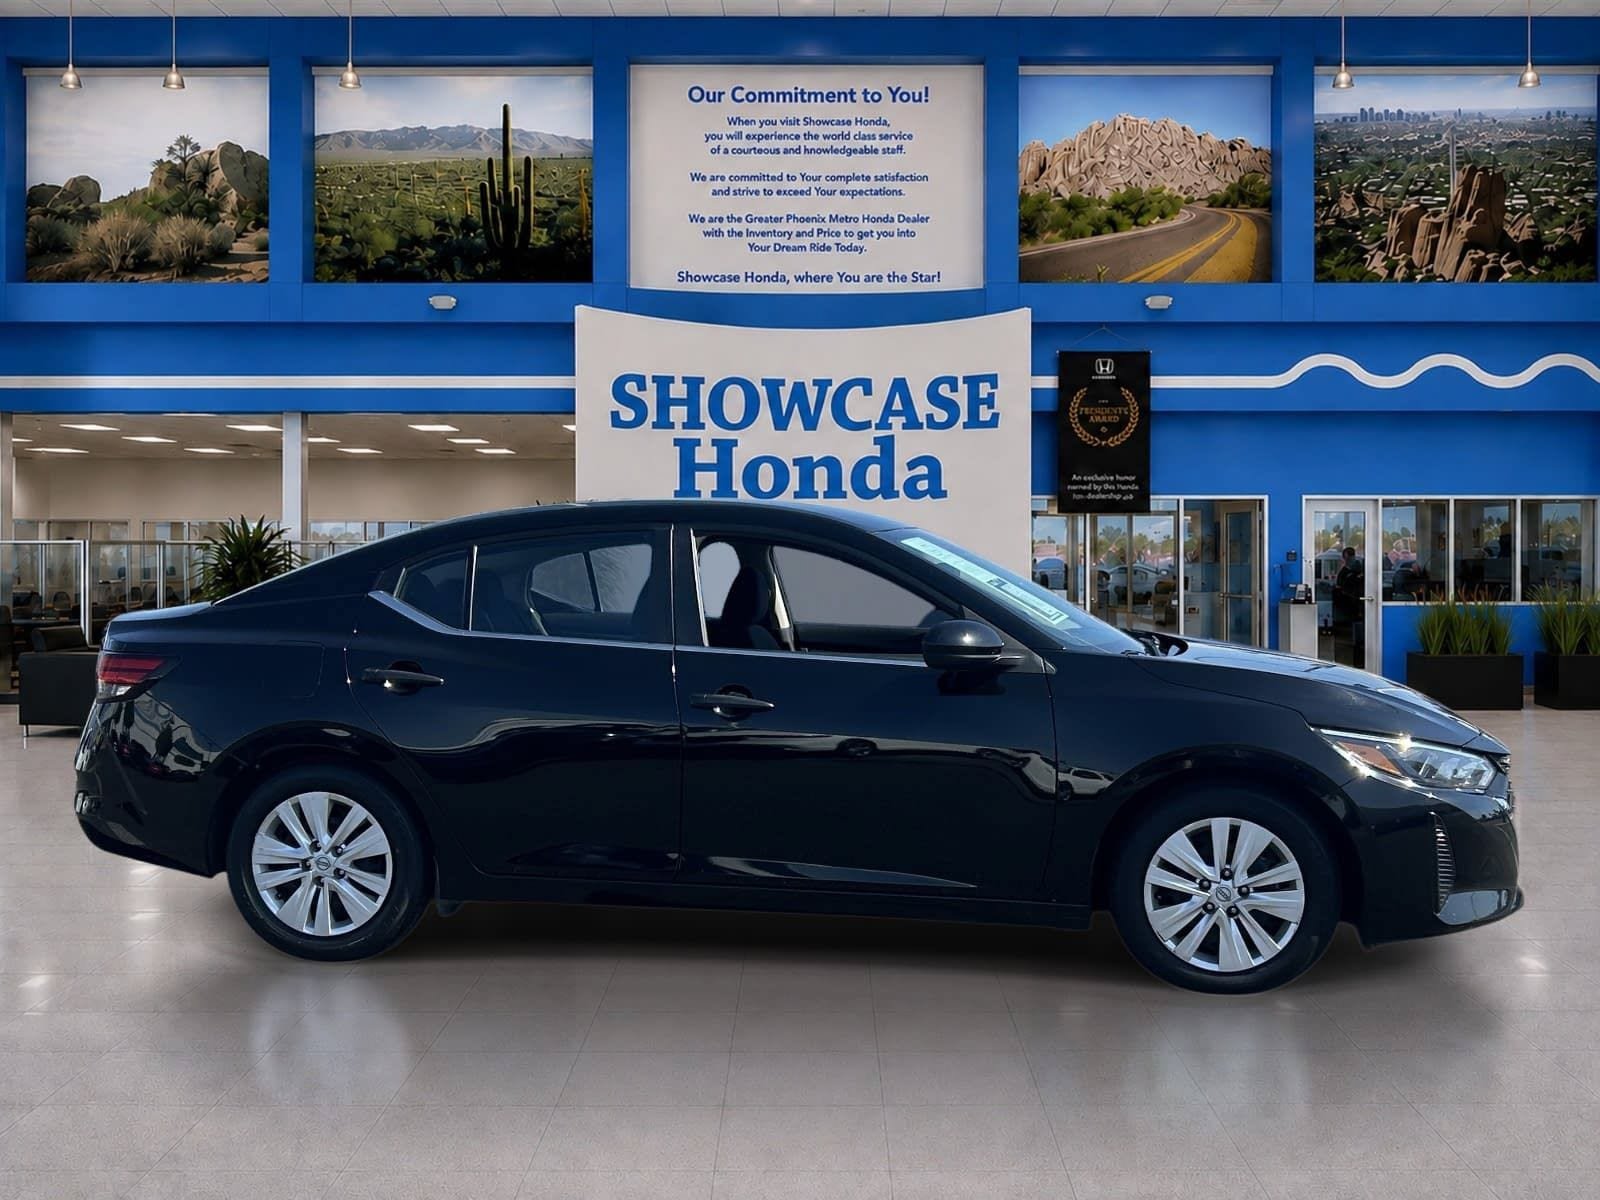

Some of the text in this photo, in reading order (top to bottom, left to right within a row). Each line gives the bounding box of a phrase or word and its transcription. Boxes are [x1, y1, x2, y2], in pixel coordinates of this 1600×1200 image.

[687, 86, 930, 104] Our Commitment to You!
[726, 116, 891, 129] When you visit Showcase Honda,
[704, 131, 914, 144] you will experience the world class service
[709, 145, 722, 156] of
[730, 147, 782, 156] courteous
[782, 145, 802, 156] and
[881, 145, 907, 156] staff.
[689, 172, 929, 185] We are committed to Your complete satisfaction
[711, 186, 906, 200] and strive to exceed Your expectations.
[687, 214, 931, 224] We are the Greater Phoenix Metro Honda Dealer
[702, 228, 917, 241] with the Inventory and Price to get you into
[747, 243, 868, 255] Your Dream Ride Today.
[676, 271, 941, 286] Showcase Honda, where You are the Star!
[610, 372, 1000, 431] SHOWCASE
[673, 434, 948, 499] Honda
